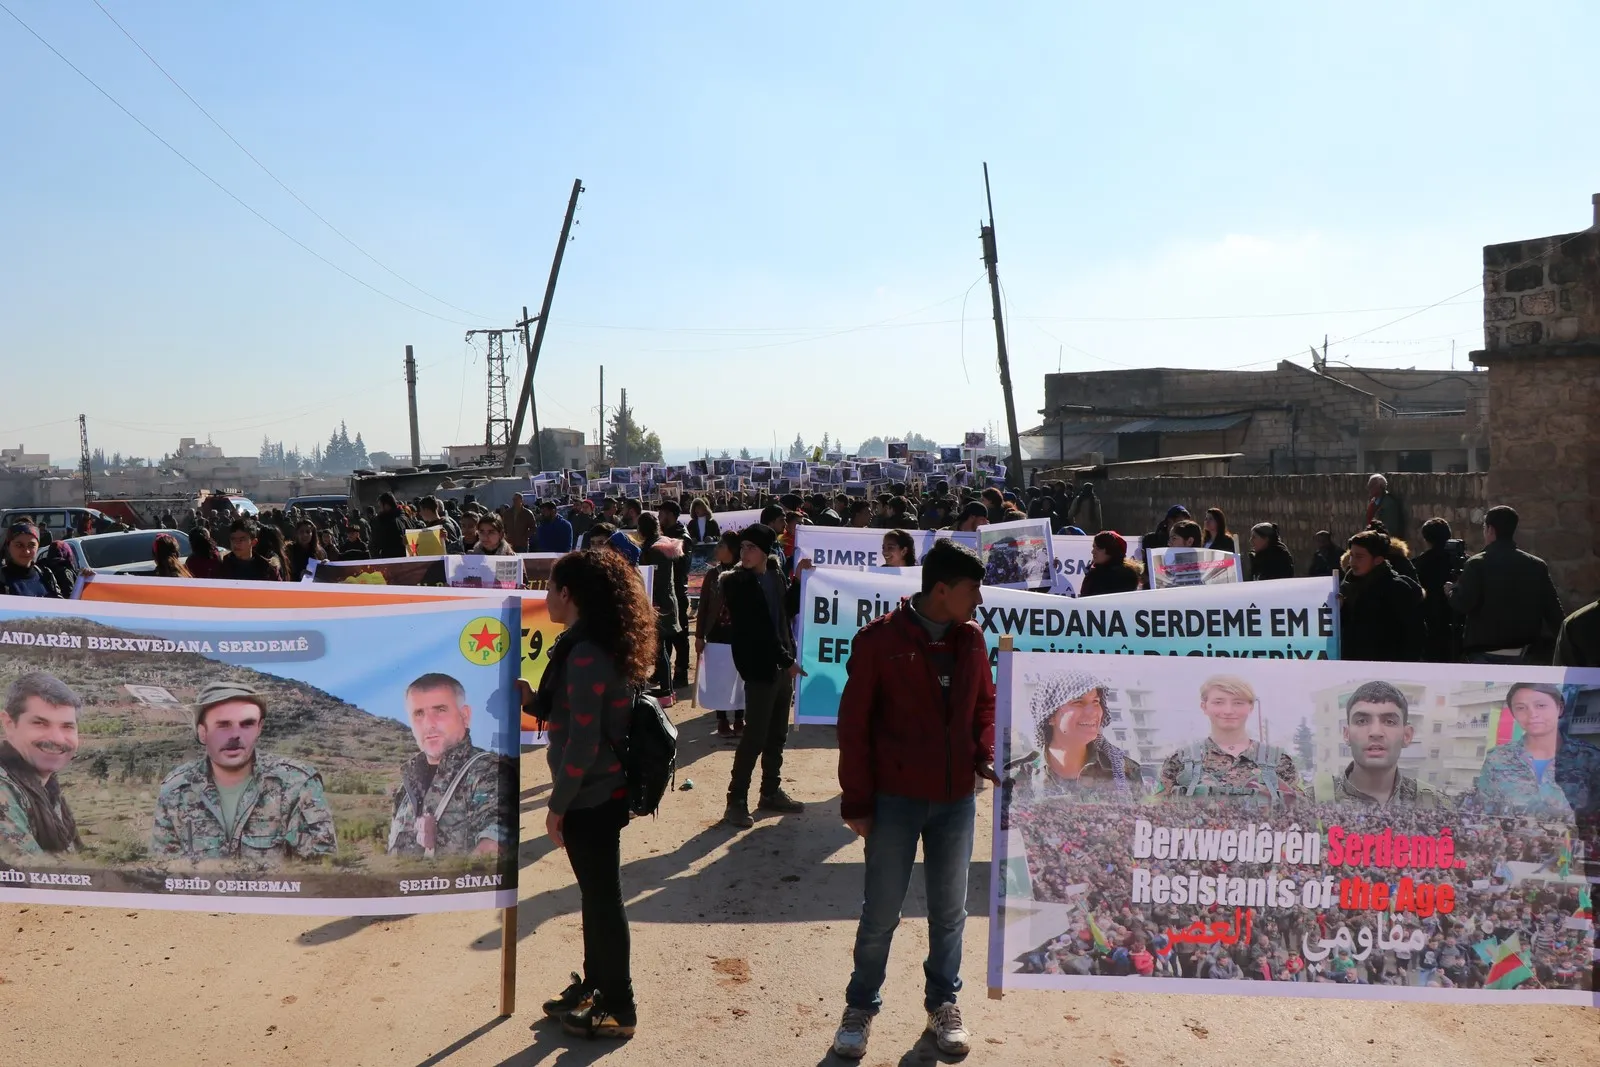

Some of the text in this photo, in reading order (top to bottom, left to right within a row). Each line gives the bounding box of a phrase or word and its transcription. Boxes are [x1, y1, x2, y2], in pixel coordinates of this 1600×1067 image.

[813, 548, 878, 567] BIMRE
[973, 602, 1334, 638] XWEDANA SERDEMÊ EM Ê
[0, 630, 309, 653] ANDARÊN BERXWEDANA SERDEMÊ
[467, 640, 503, 661] YPG
[817, 637, 850, 664] EF
[1132, 819, 1321, 866] Berxwedêrên
[0, 868, 93, 887] HÎD KARKER
[164, 876, 302, 894] ŞEHÎD QEHREMAN
[399, 873, 503, 895] ŞEHÎD SÎNAN
[1131, 868, 1456, 918] Resistants of the Age
[1155, 906, 1429, 974] مقاومي العصر
